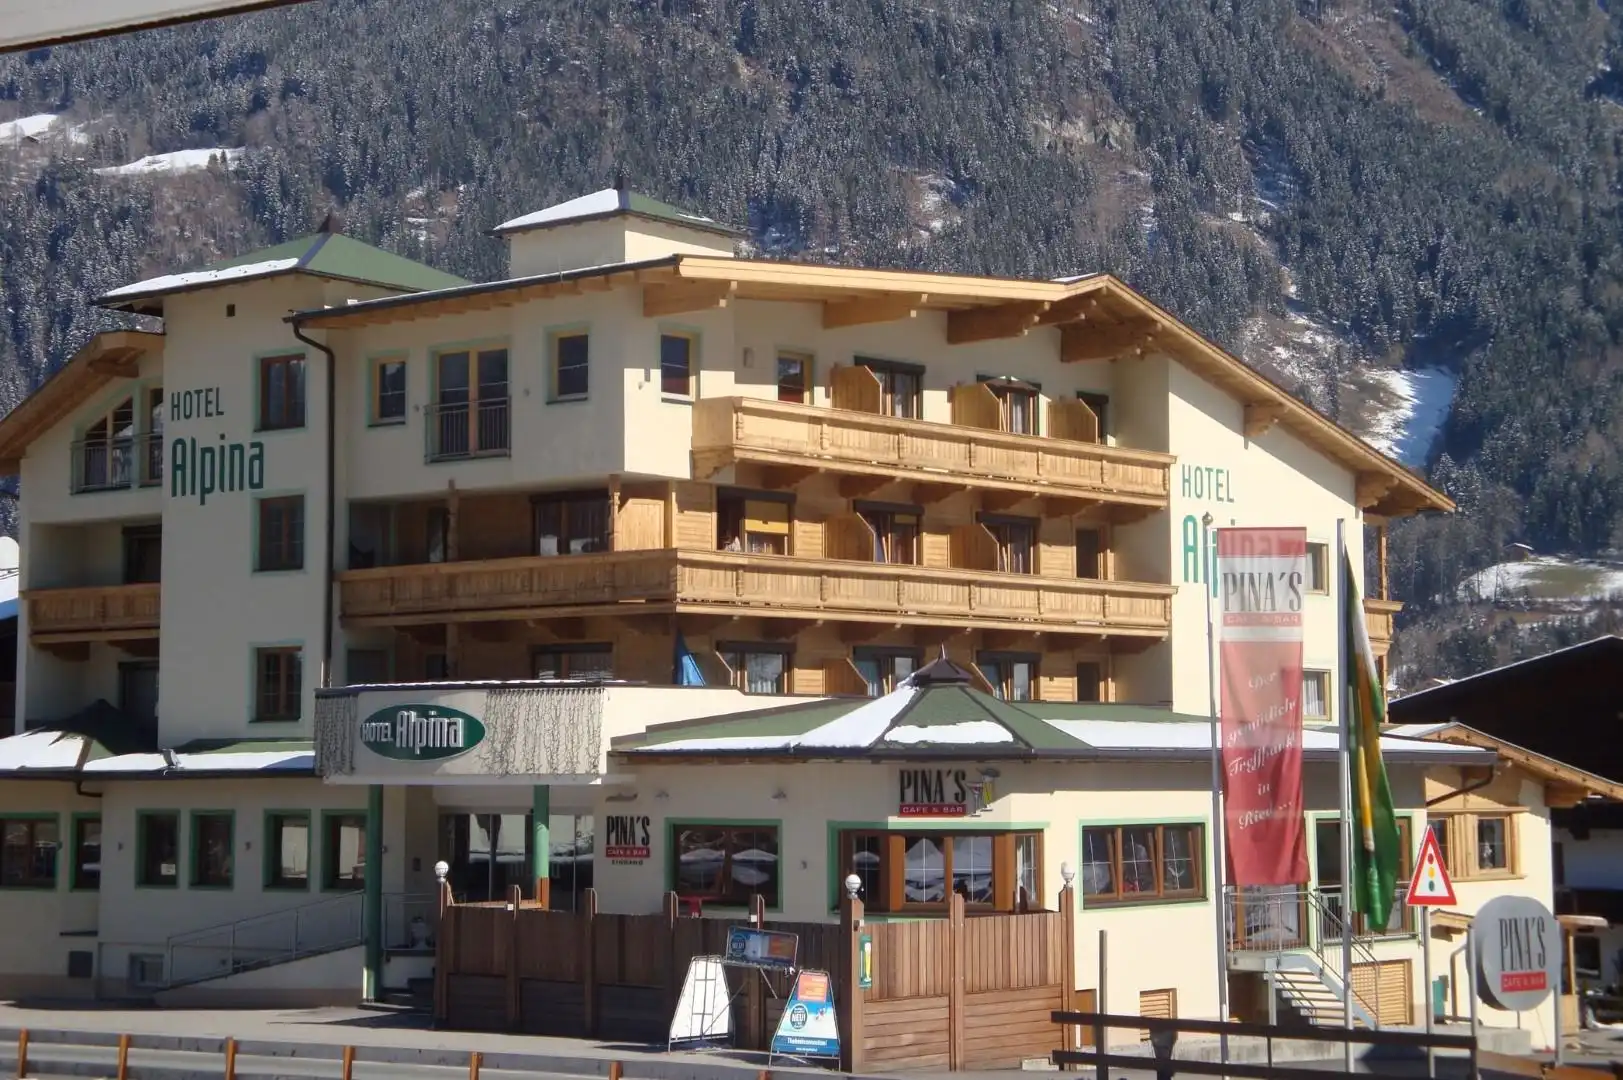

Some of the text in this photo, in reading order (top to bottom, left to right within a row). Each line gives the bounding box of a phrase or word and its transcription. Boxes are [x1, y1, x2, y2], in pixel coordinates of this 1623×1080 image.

[171, 387, 225, 421] HOTEL
[171, 433, 264, 506] Alpina
[1182, 464, 1235, 503] HOTEL
[361, 710, 465, 755] HOTEL Alpina
[1258, 783, 1271, 796] in
